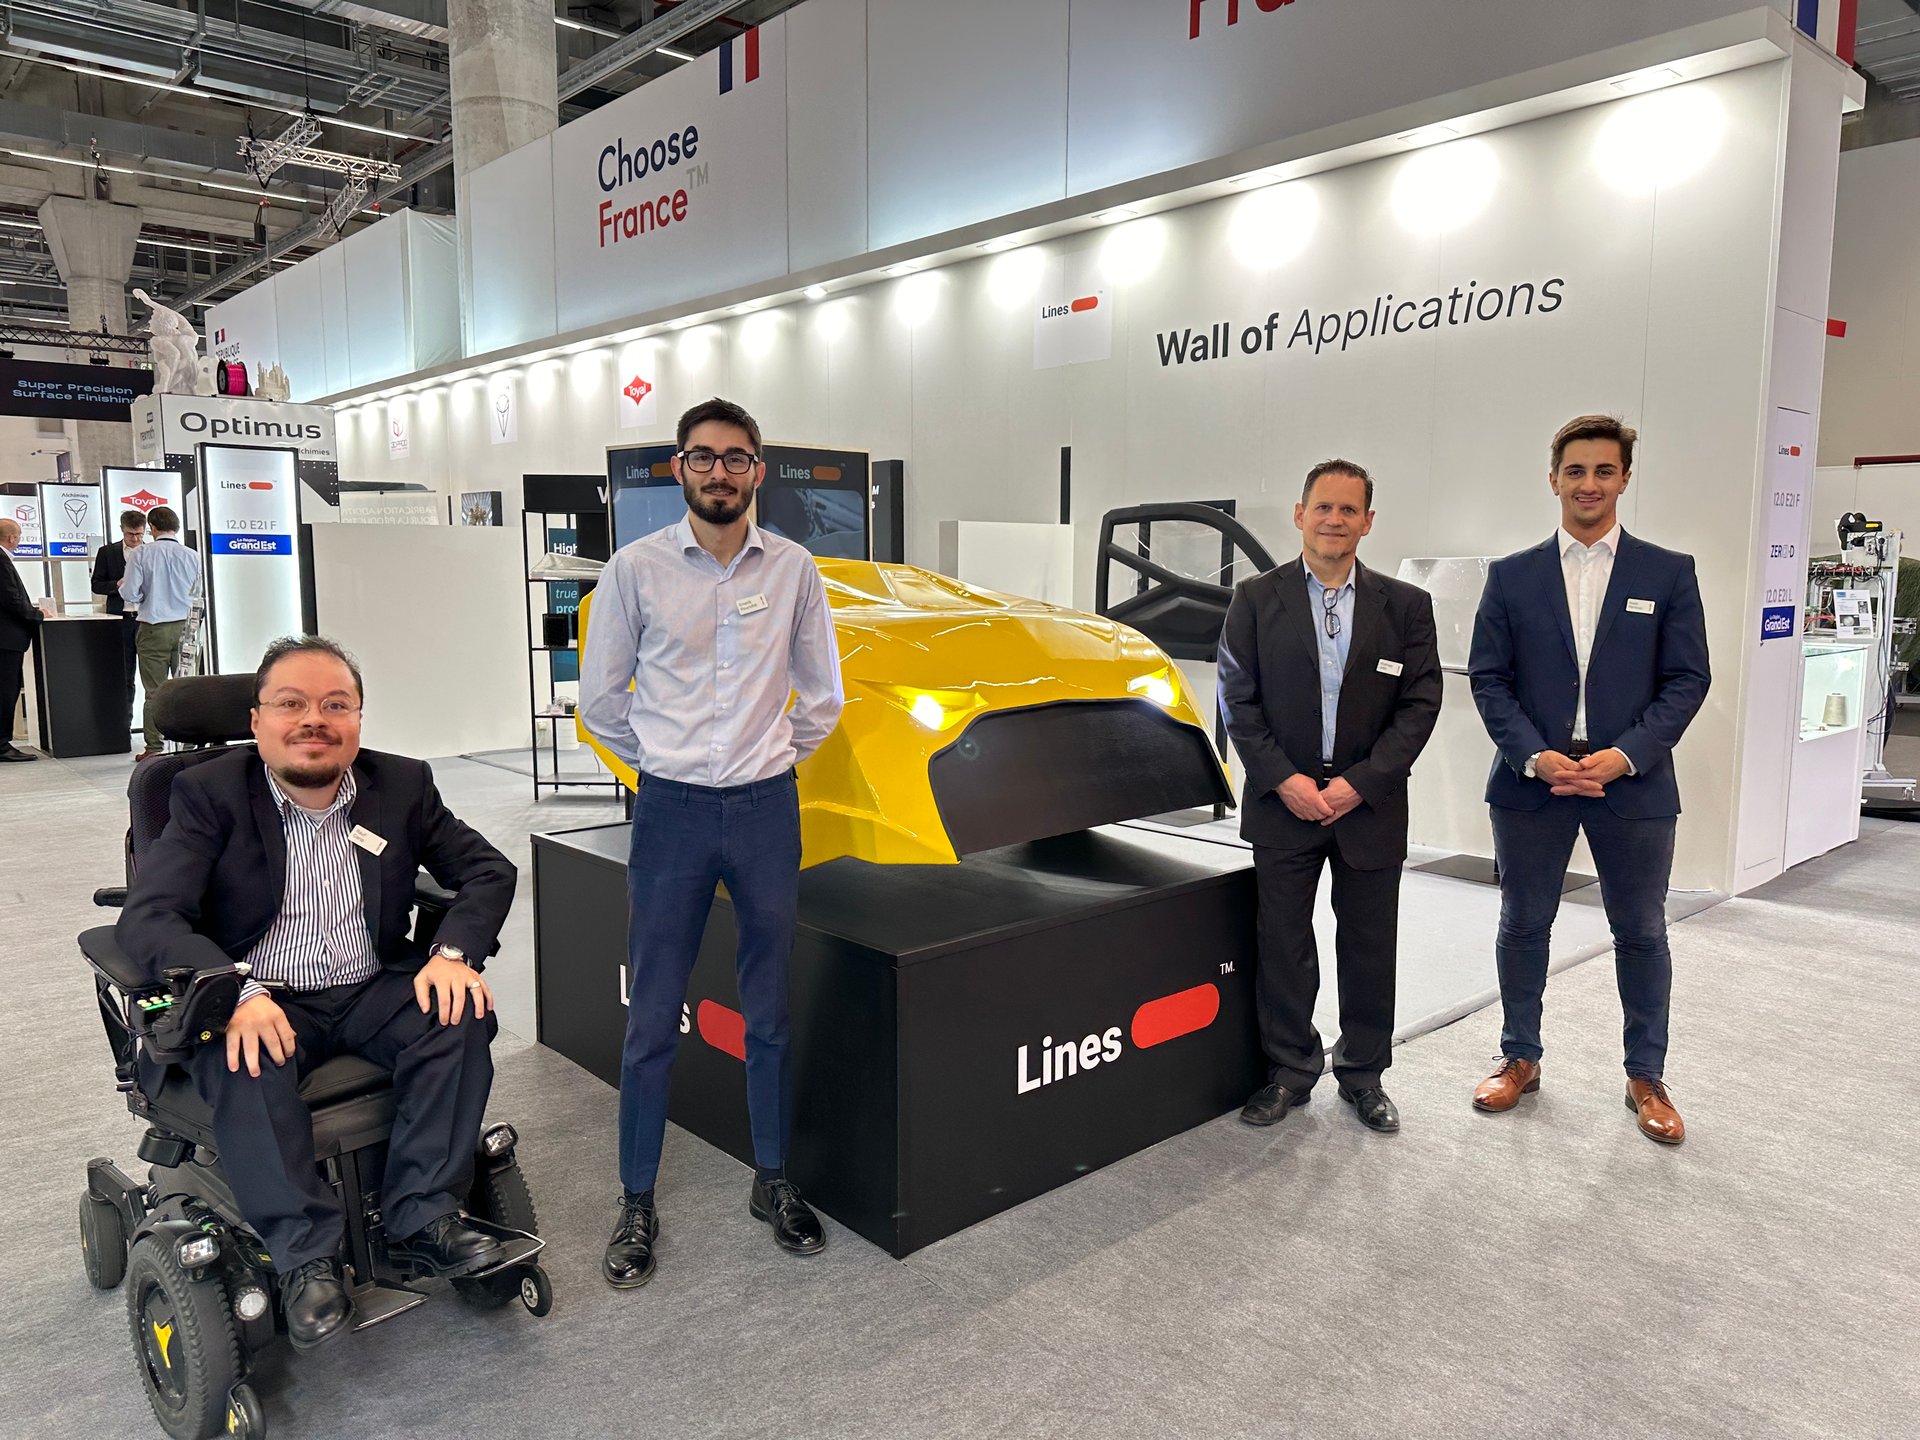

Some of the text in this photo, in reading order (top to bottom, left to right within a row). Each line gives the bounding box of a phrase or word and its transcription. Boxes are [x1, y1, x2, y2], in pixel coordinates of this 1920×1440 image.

[598, 125, 699, 192] Choose
[599, 189, 688, 248] France
[1042, 305, 1069, 319] Lines
[1156, 277, 1565, 367] Wall of Applications
[12, 389, 72, 400] Surface
[18, 380, 133, 395] Super Precision
[629, 383, 647, 398] Toyal
[180, 412, 322, 439] Optimus
[625, 465, 650, 480] Lines
[779, 464, 811, 480] Lines
[220, 480, 247, 489] Lines
[130, 497, 159, 507] Toyal
[226, 520, 277, 530] 12.0 E21 F
[556, 588, 578, 599] true
[1017, 1026, 1123, 1095] Lines
